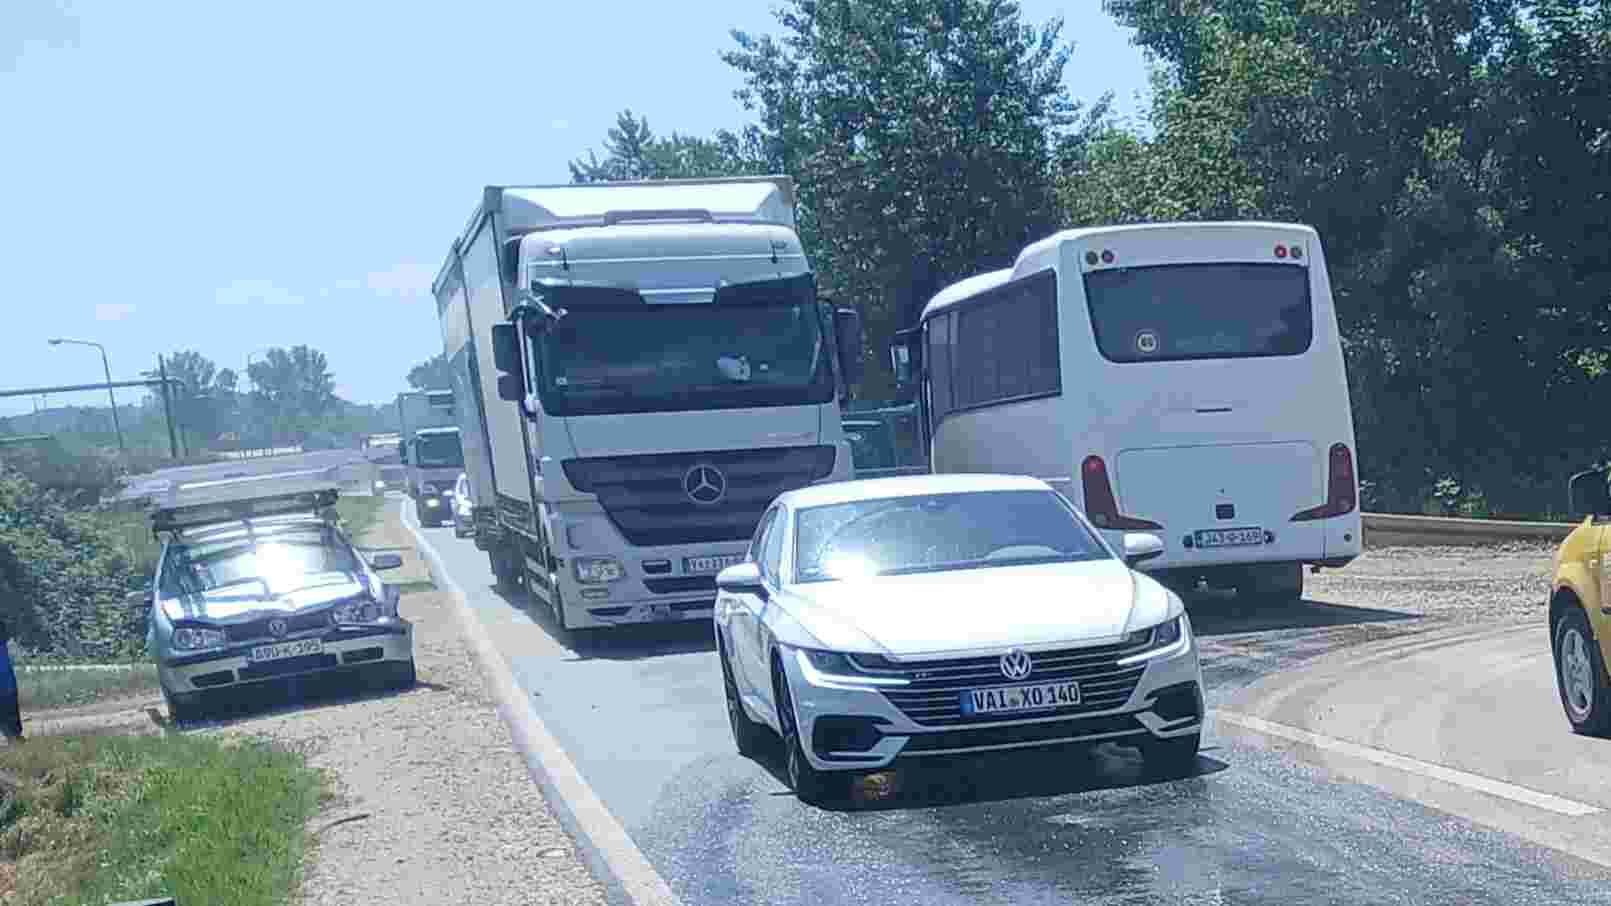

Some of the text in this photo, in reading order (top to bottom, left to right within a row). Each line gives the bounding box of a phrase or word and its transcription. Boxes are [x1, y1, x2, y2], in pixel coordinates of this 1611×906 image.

[1000, 649, 1032, 680] VW
[974, 689, 1008, 710] VAI
[1047, 683, 1079, 705] 140
